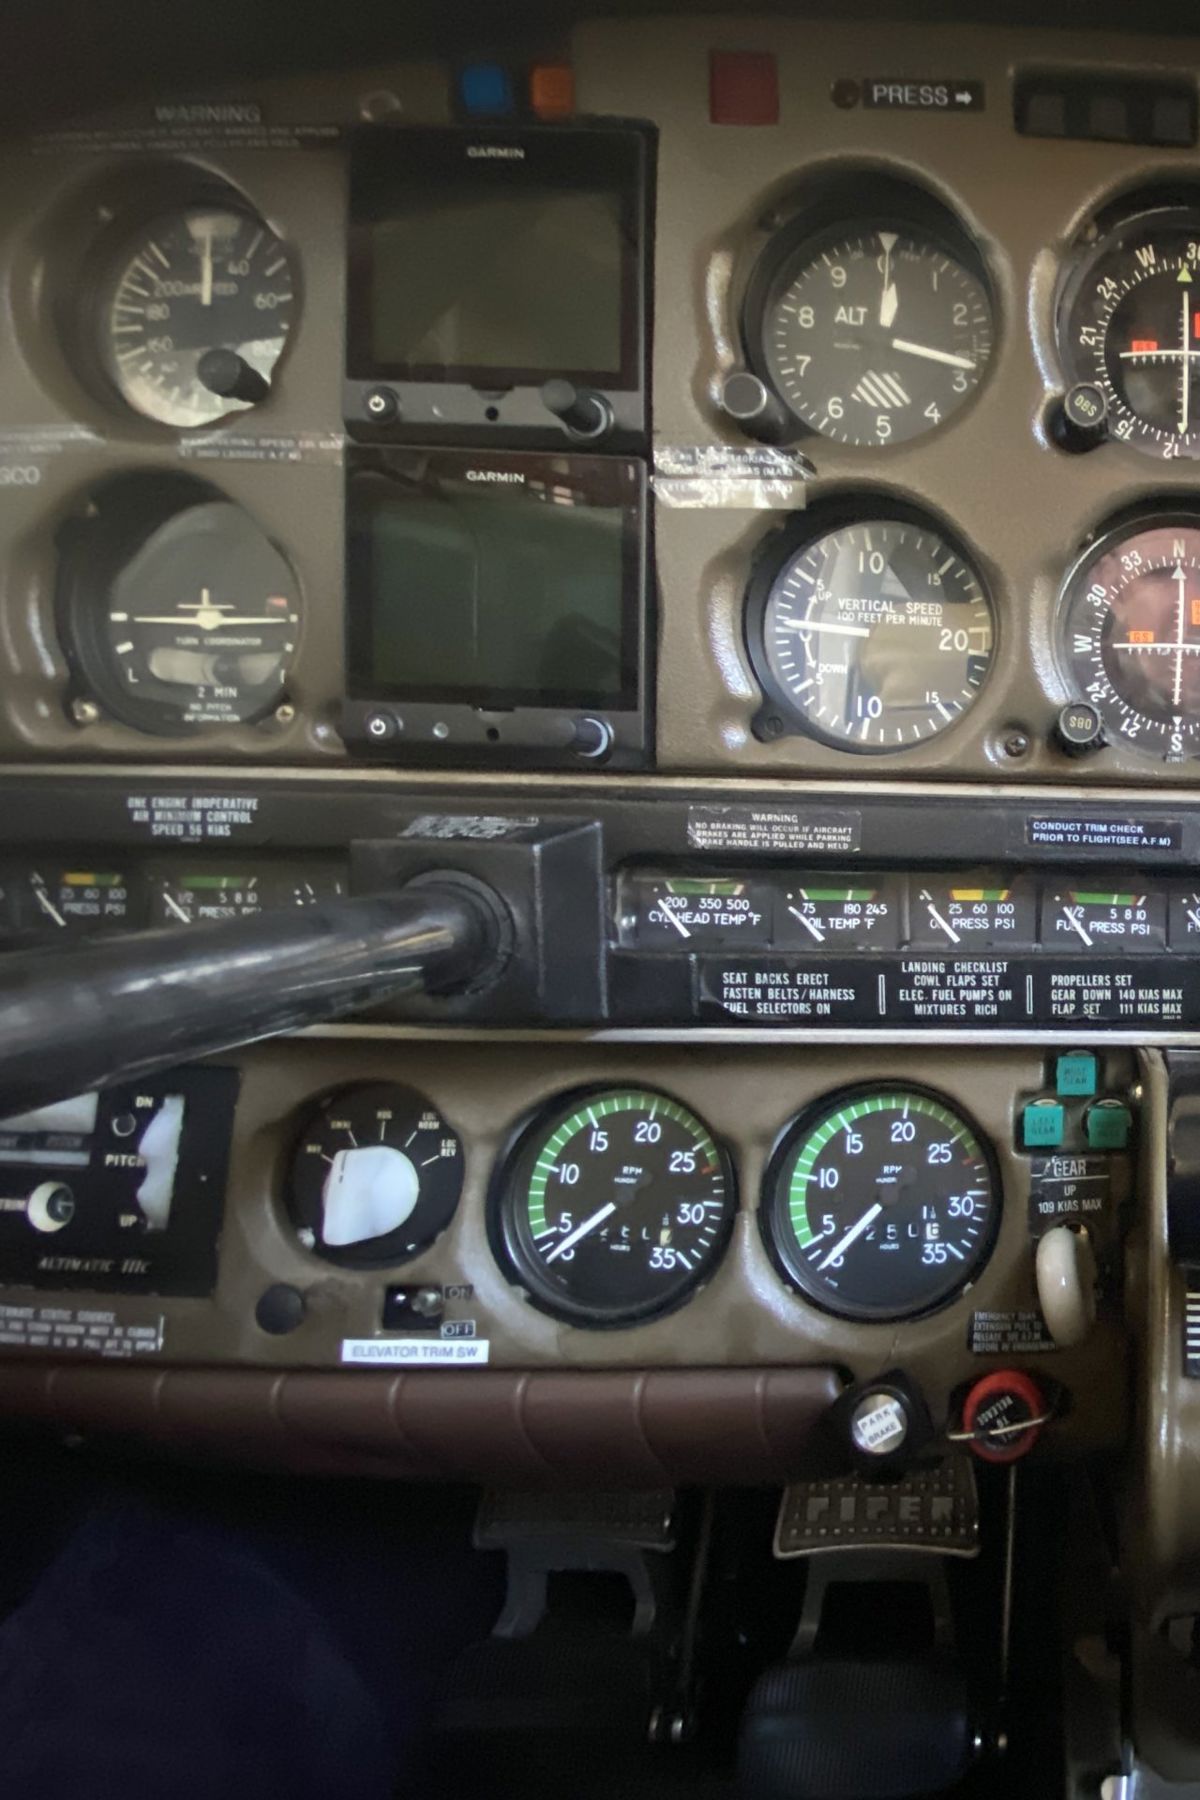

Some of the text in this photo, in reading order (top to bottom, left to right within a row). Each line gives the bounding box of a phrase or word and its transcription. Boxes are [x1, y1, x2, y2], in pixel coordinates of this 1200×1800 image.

[873, 84, 948, 105] PRESS
[155, 105, 260, 122] WARNING
[467, 147, 524, 159] GARMIN
[831, 306, 869, 326] ALT
[466, 471, 525, 484] GARMIN
[859, 552, 884, 574] 10
[838, 599, 943, 615] VERTICAL SPEED
[938, 629, 968, 651] 20
[818, 663, 848, 674] DOWN
[857, 695, 882, 718] 10
[128, 798, 258, 811] ONE ENGINE INOPERATIVE
[751, 812, 798, 823] WARNING
[152, 824, 183, 836] SPEED
[208, 825, 231, 836] KIAS
[696, 822, 853, 835] NO BRAKING WILL OCCUR IF AIRCRAFT
[1032, 821, 1144, 835] CONDUCT TRIM CHECK
[104, 903, 126, 915] PSI
[726, 899, 750, 911] 500
[802, 903, 816, 914] 75
[865, 904, 888, 916] 245
[949, 903, 963, 914] 25
[973, 903, 988, 914] 60
[997, 903, 1014, 915] 100
[952, 918, 1016, 930] PRESS PSI
[901, 961, 1008, 973] LANDING CHECKLIST
[722, 972, 830, 985] SEAT BACKS ERECT
[914, 975, 1000, 986] COWL FLAPS SET
[1051, 975, 1133, 986] PROPELLERS SET
[723, 988, 761, 1000] FASTEN
[899, 989, 1012, 1001] ELEC. FUEL PUMPS ON
[1051, 989, 1183, 1000] GEAR DOWN 140 KIAS MAX
[723, 1003, 831, 1014] FUEL SELECTORS ON
[915, 1003, 997, 1015] MIXTURES RICH
[1051, 1003, 1182, 1015] FLAP SET 111 KIAS MAX
[135, 1095, 154, 1109] DN
[634, 1121, 662, 1143] 20
[891, 1121, 916, 1142] 20
[590, 1131, 608, 1152] 15
[846, 1134, 863, 1154] 15
[927, 1143, 952, 1164] 25
[669, 1152, 696, 1173] 25
[1053, 1160, 1087, 1177] GEAR
[559, 1164, 579, 1184] 10
[622, 1166, 642, 1175] RPM
[820, 1168, 838, 1188] 10
[1064, 1185, 1076, 1197] UP
[947, 1196, 974, 1216] 30
[1038, 1198, 1103, 1214] 109 KIAS MAX
[677, 1203, 705, 1224] 30
[559, 1212, 573, 1232] 5
[822, 1214, 835, 1234] 5
[648, 1247, 676, 1269] 35
[922, 1243, 947, 1264] 35
[39, 1256, 115, 1272] ALTIMATIC
[352, 1346, 478, 1359] ELEVATOR TRIM SW
[807, 1497, 953, 1521] PIPER
